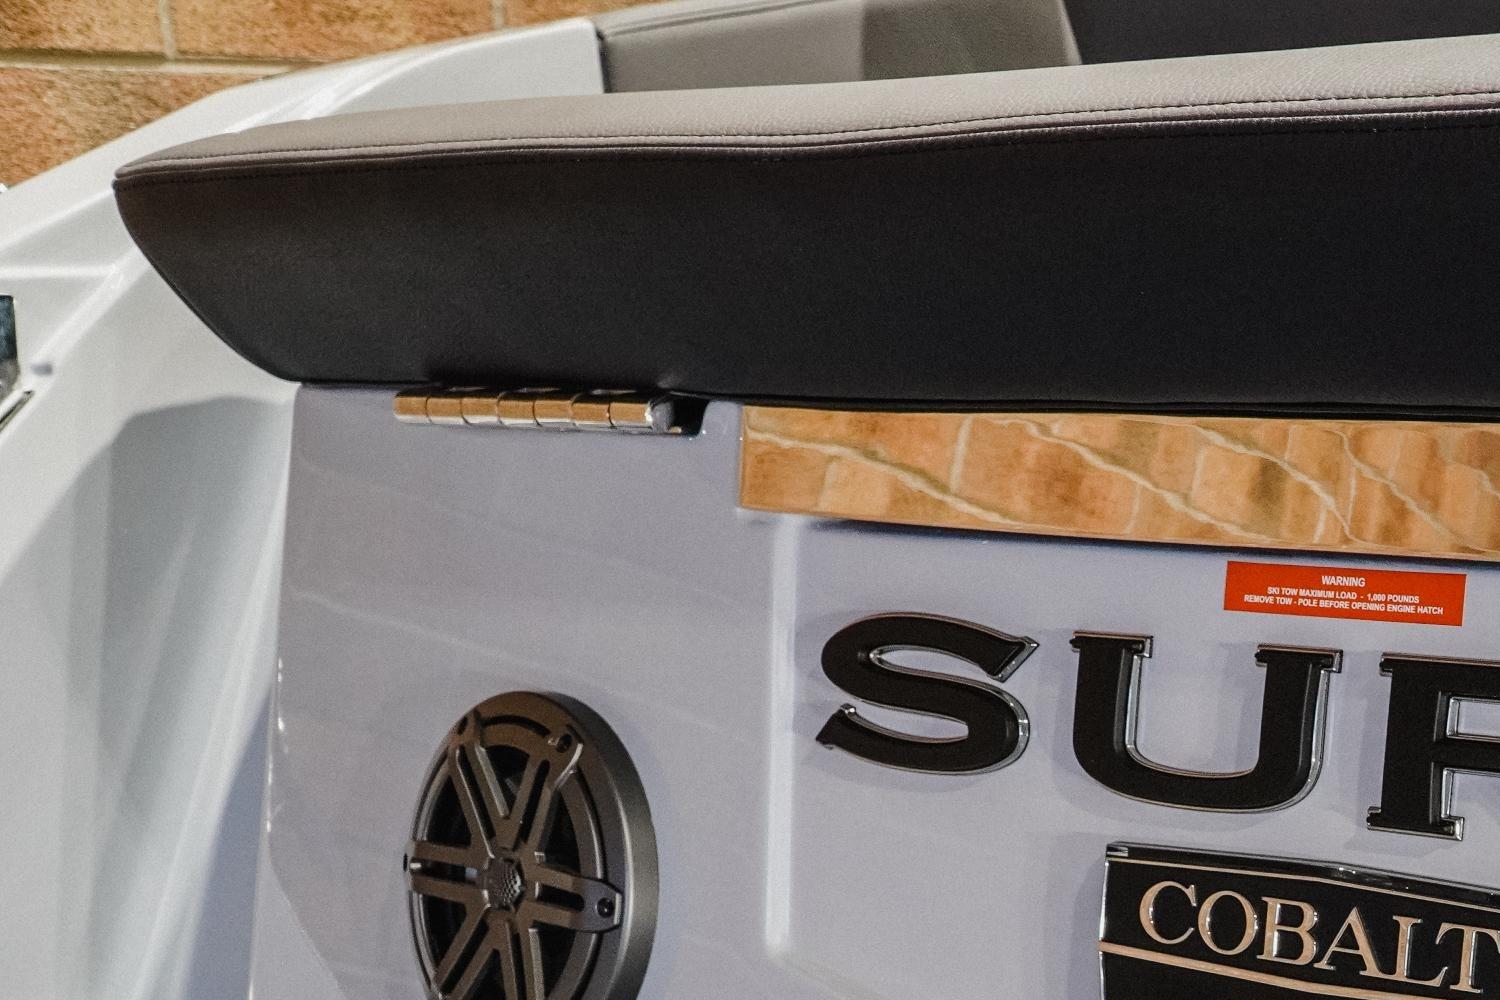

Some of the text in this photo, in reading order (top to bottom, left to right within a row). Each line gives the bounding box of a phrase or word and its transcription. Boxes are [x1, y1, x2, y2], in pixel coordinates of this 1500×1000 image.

[1322, 576, 1365, 587] WARNING
[1267, 587, 1280, 595] SKI
[1281, 588, 1297, 596] TOW
[1299, 589, 1334, 598] MAXIMUM
[1336, 591, 1357, 599] LOAD
[1387, 594, 1419, 604] POUNDS
[1244, 595, 1274, 604] REMOVE
[1276, 597, 1292, 606] TOW
[1298, 599, 1318, 607] POLE
[1320, 600, 1349, 609] BEFORE
[1352, 602, 1385, 611] OPENING
[1387, 605, 1416, 613] ENGINE
[1417, 606, 1443, 615] HATCH
